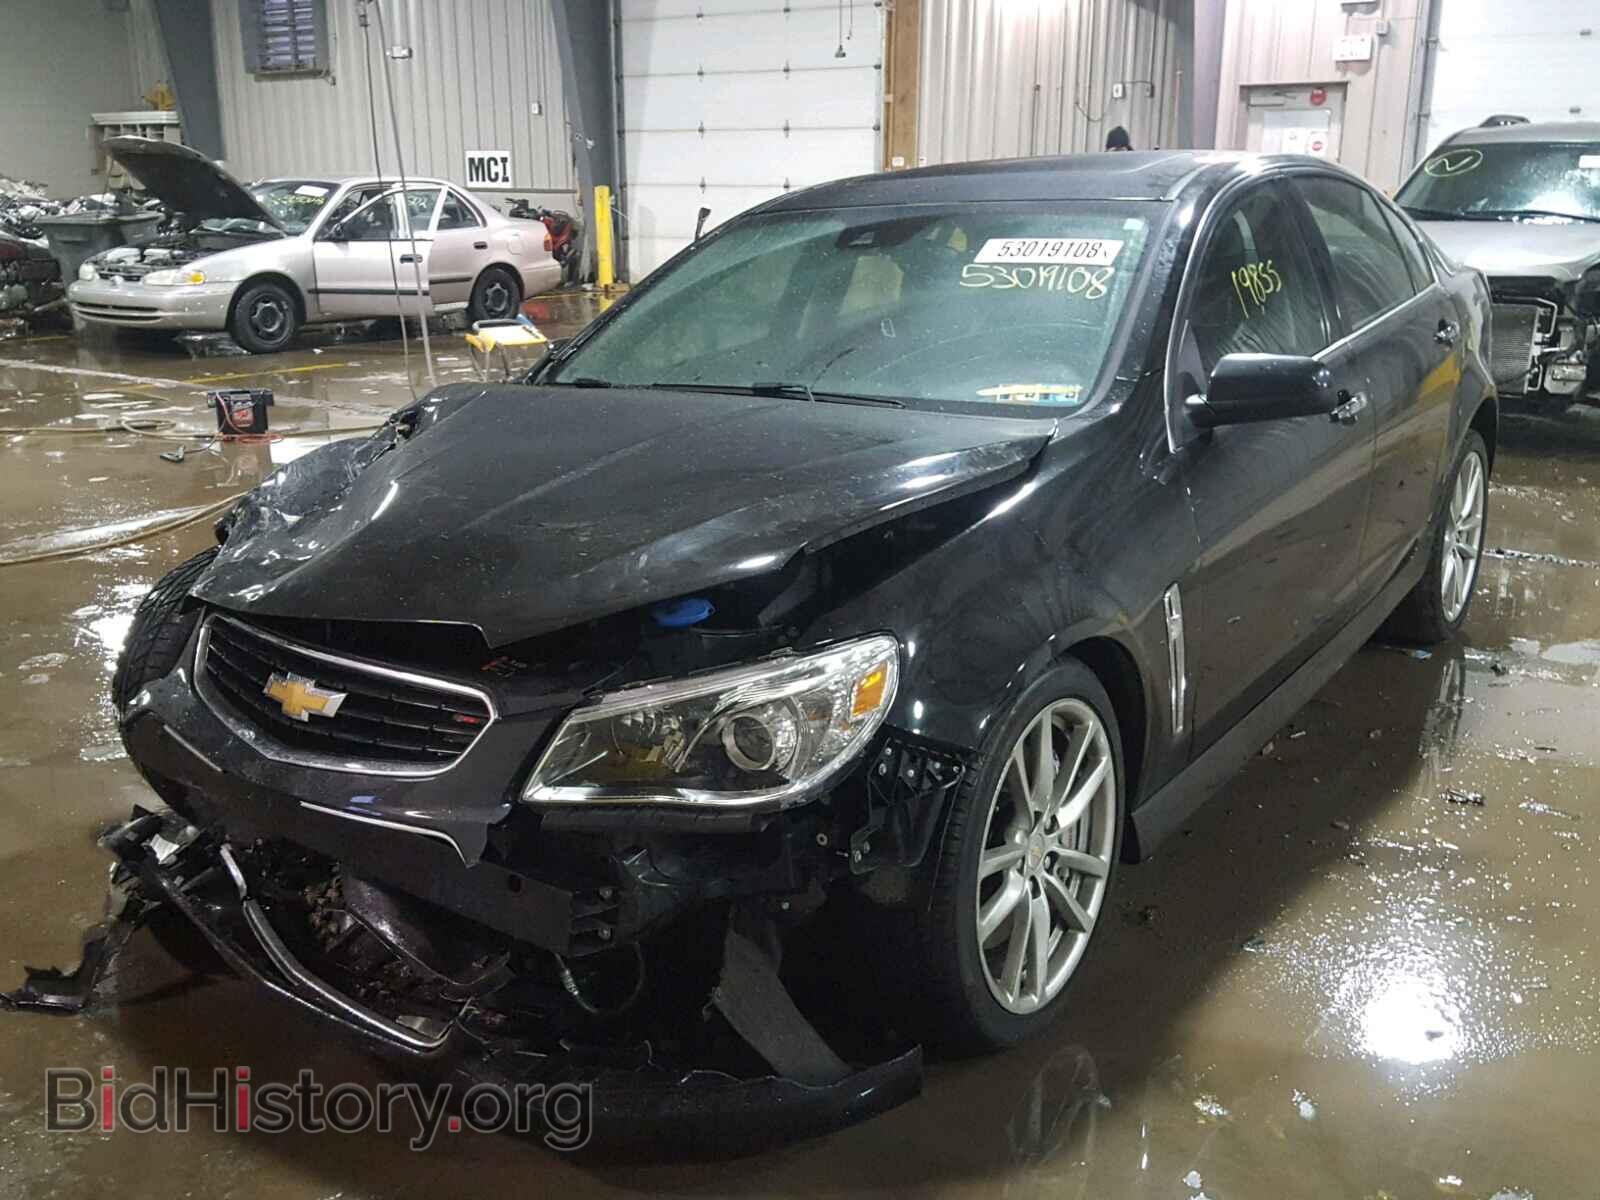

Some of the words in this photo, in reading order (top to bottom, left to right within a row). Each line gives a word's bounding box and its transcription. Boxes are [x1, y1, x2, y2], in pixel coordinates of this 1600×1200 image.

[468, 156, 510, 183] MCI
[997, 240, 1103, 259] 53019108
[959, 263, 1115, 300] 53019108
